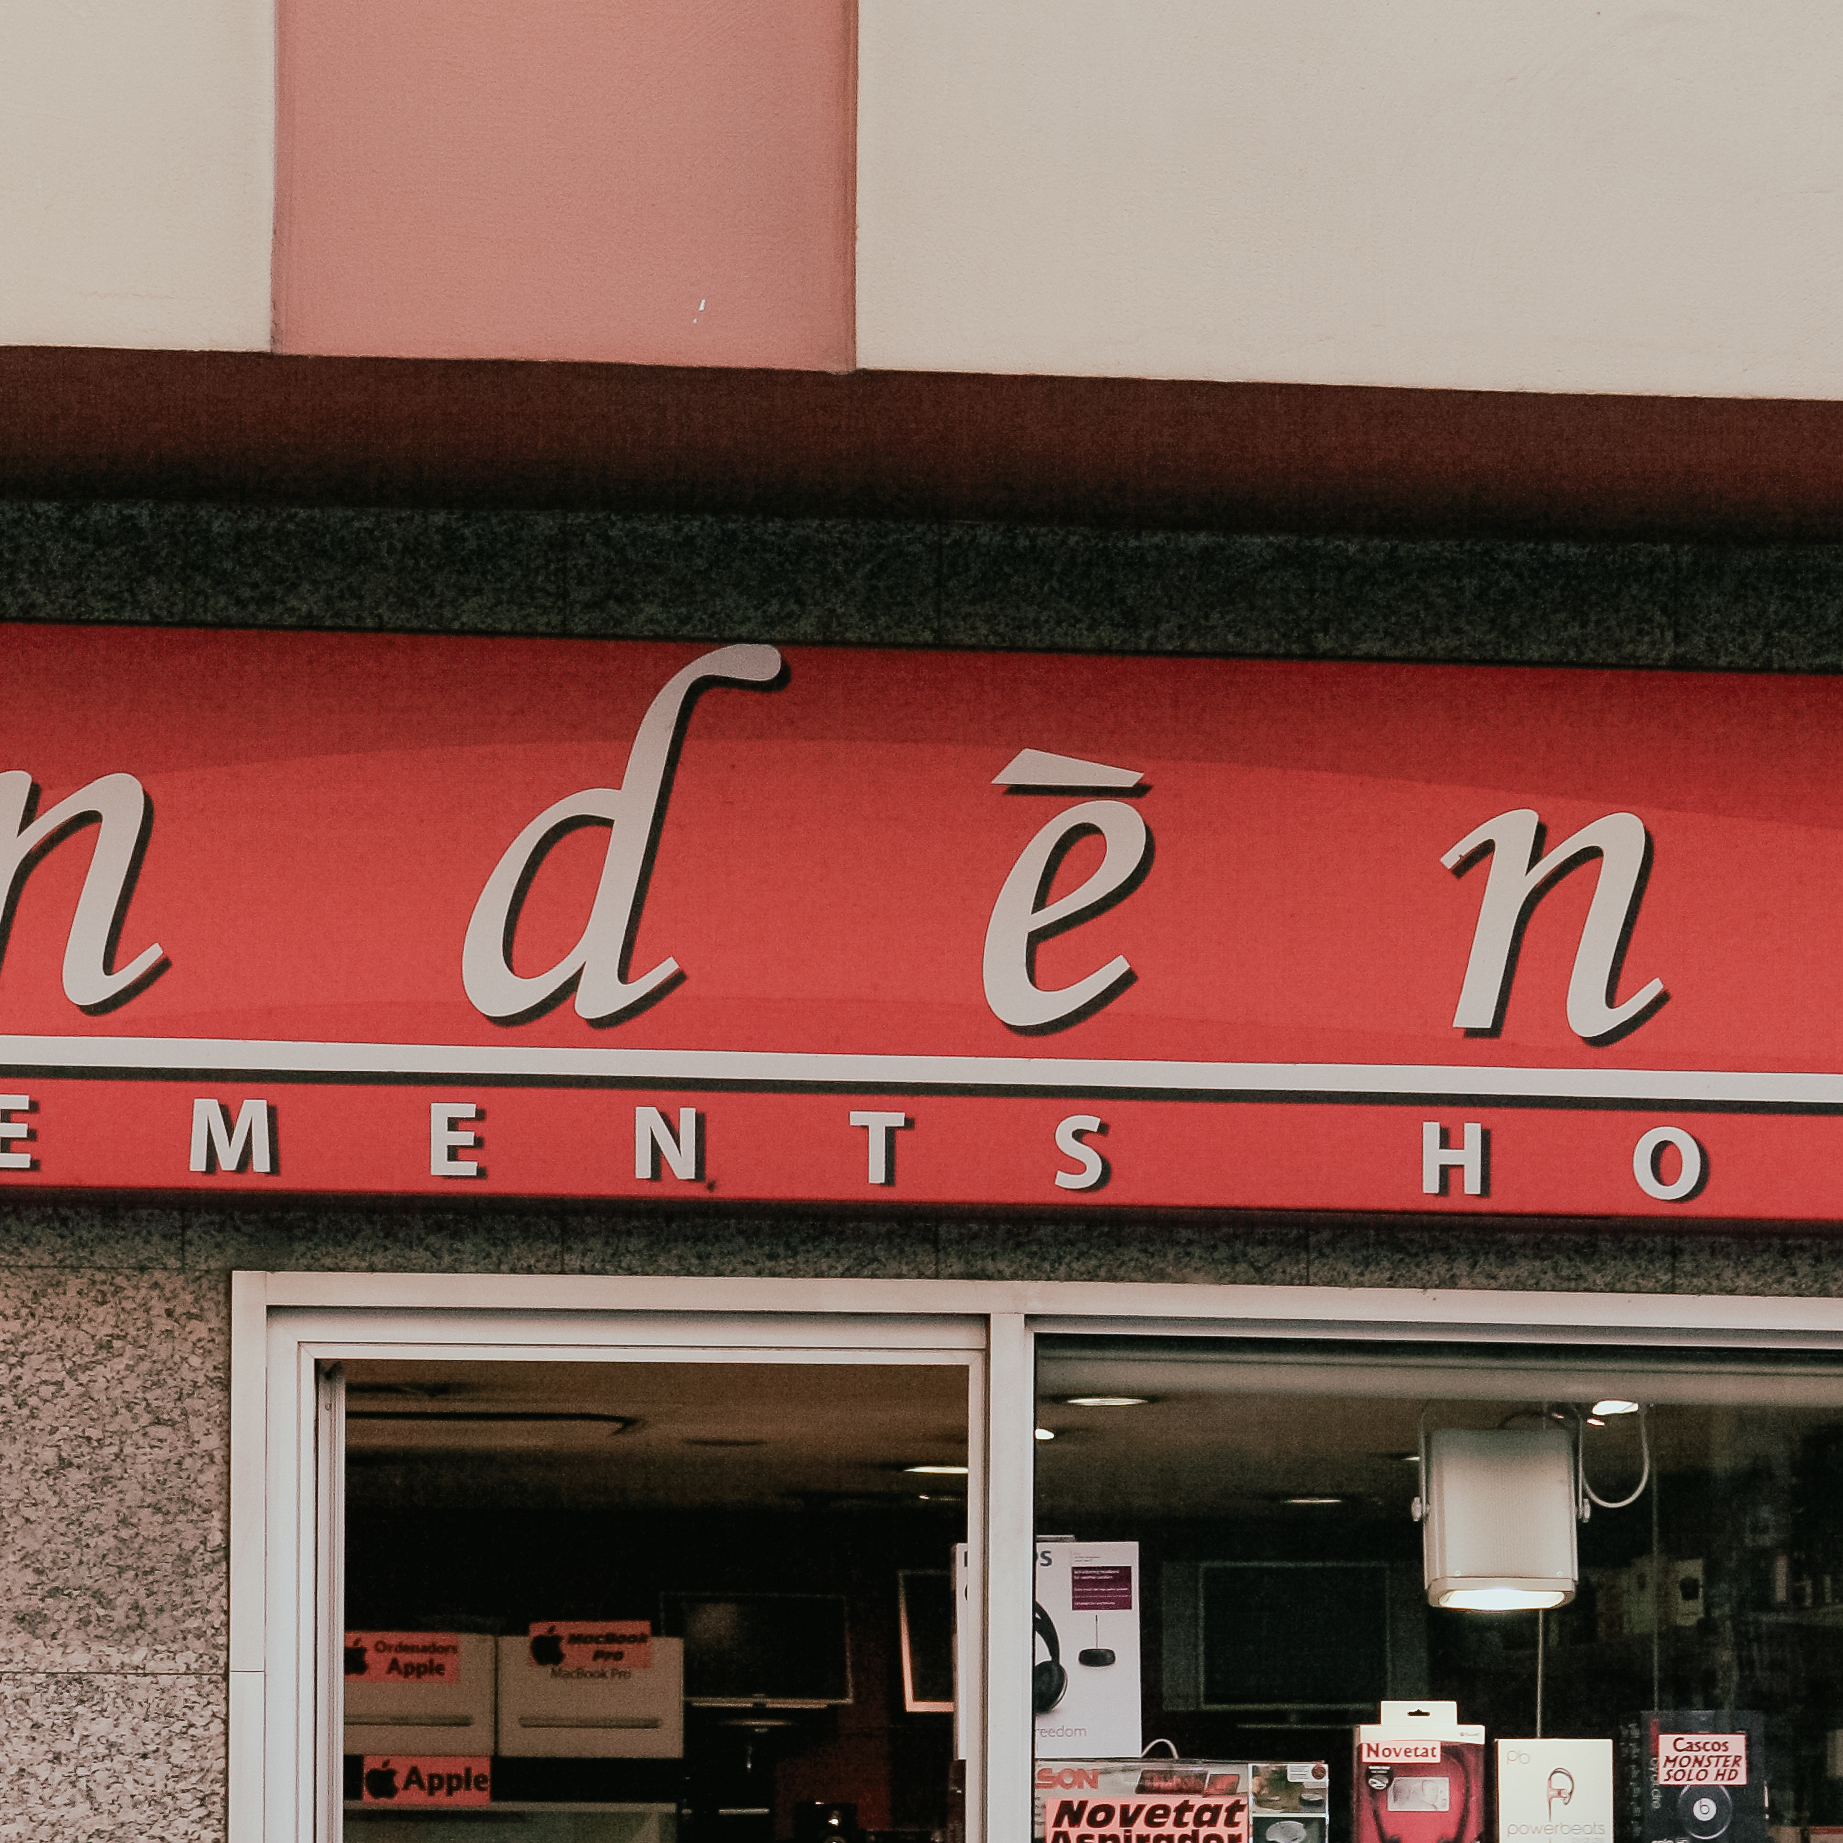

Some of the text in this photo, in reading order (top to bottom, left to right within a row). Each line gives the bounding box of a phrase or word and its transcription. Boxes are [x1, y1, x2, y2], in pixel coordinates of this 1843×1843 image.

[387, 1659, 446, 1678] Apple
[1367, 1744, 1436, 1759] Novetat
[1673, 1738, 1729, 1753] Cascos
[1664, 1754, 1742, 1768] MONSTER
[403, 1768, 489, 1794] Apple
[1664, 1768, 1738, 1781] SOLO HD
[1053, 1801, 1245, 1829] Novetat
[1507, 1822, 1605, 1837] powerbeats
